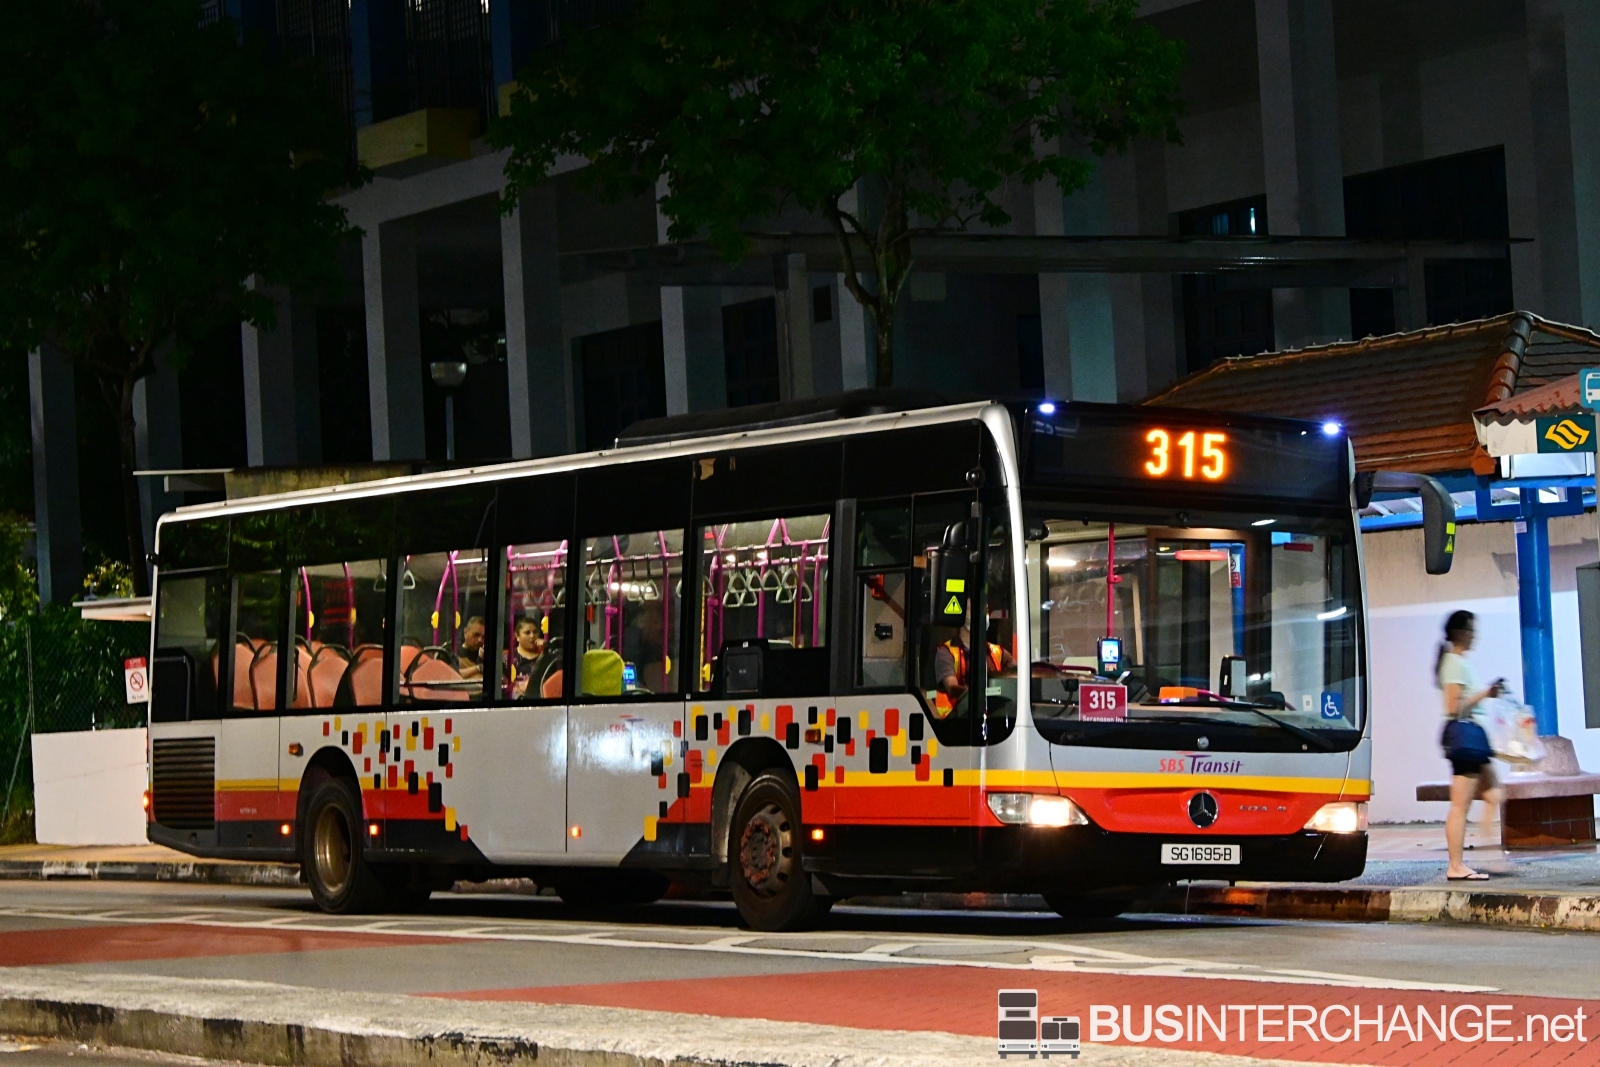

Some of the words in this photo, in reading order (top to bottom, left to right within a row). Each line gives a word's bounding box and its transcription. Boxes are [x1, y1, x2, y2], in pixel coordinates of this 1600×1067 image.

[1145, 429, 1226, 479] 315
[1089, 690, 1117, 710] 315
[1158, 757, 1185, 773] SBS
[1185, 754, 1244, 775] Transit
[1171, 847, 1232, 861] SG1695B
